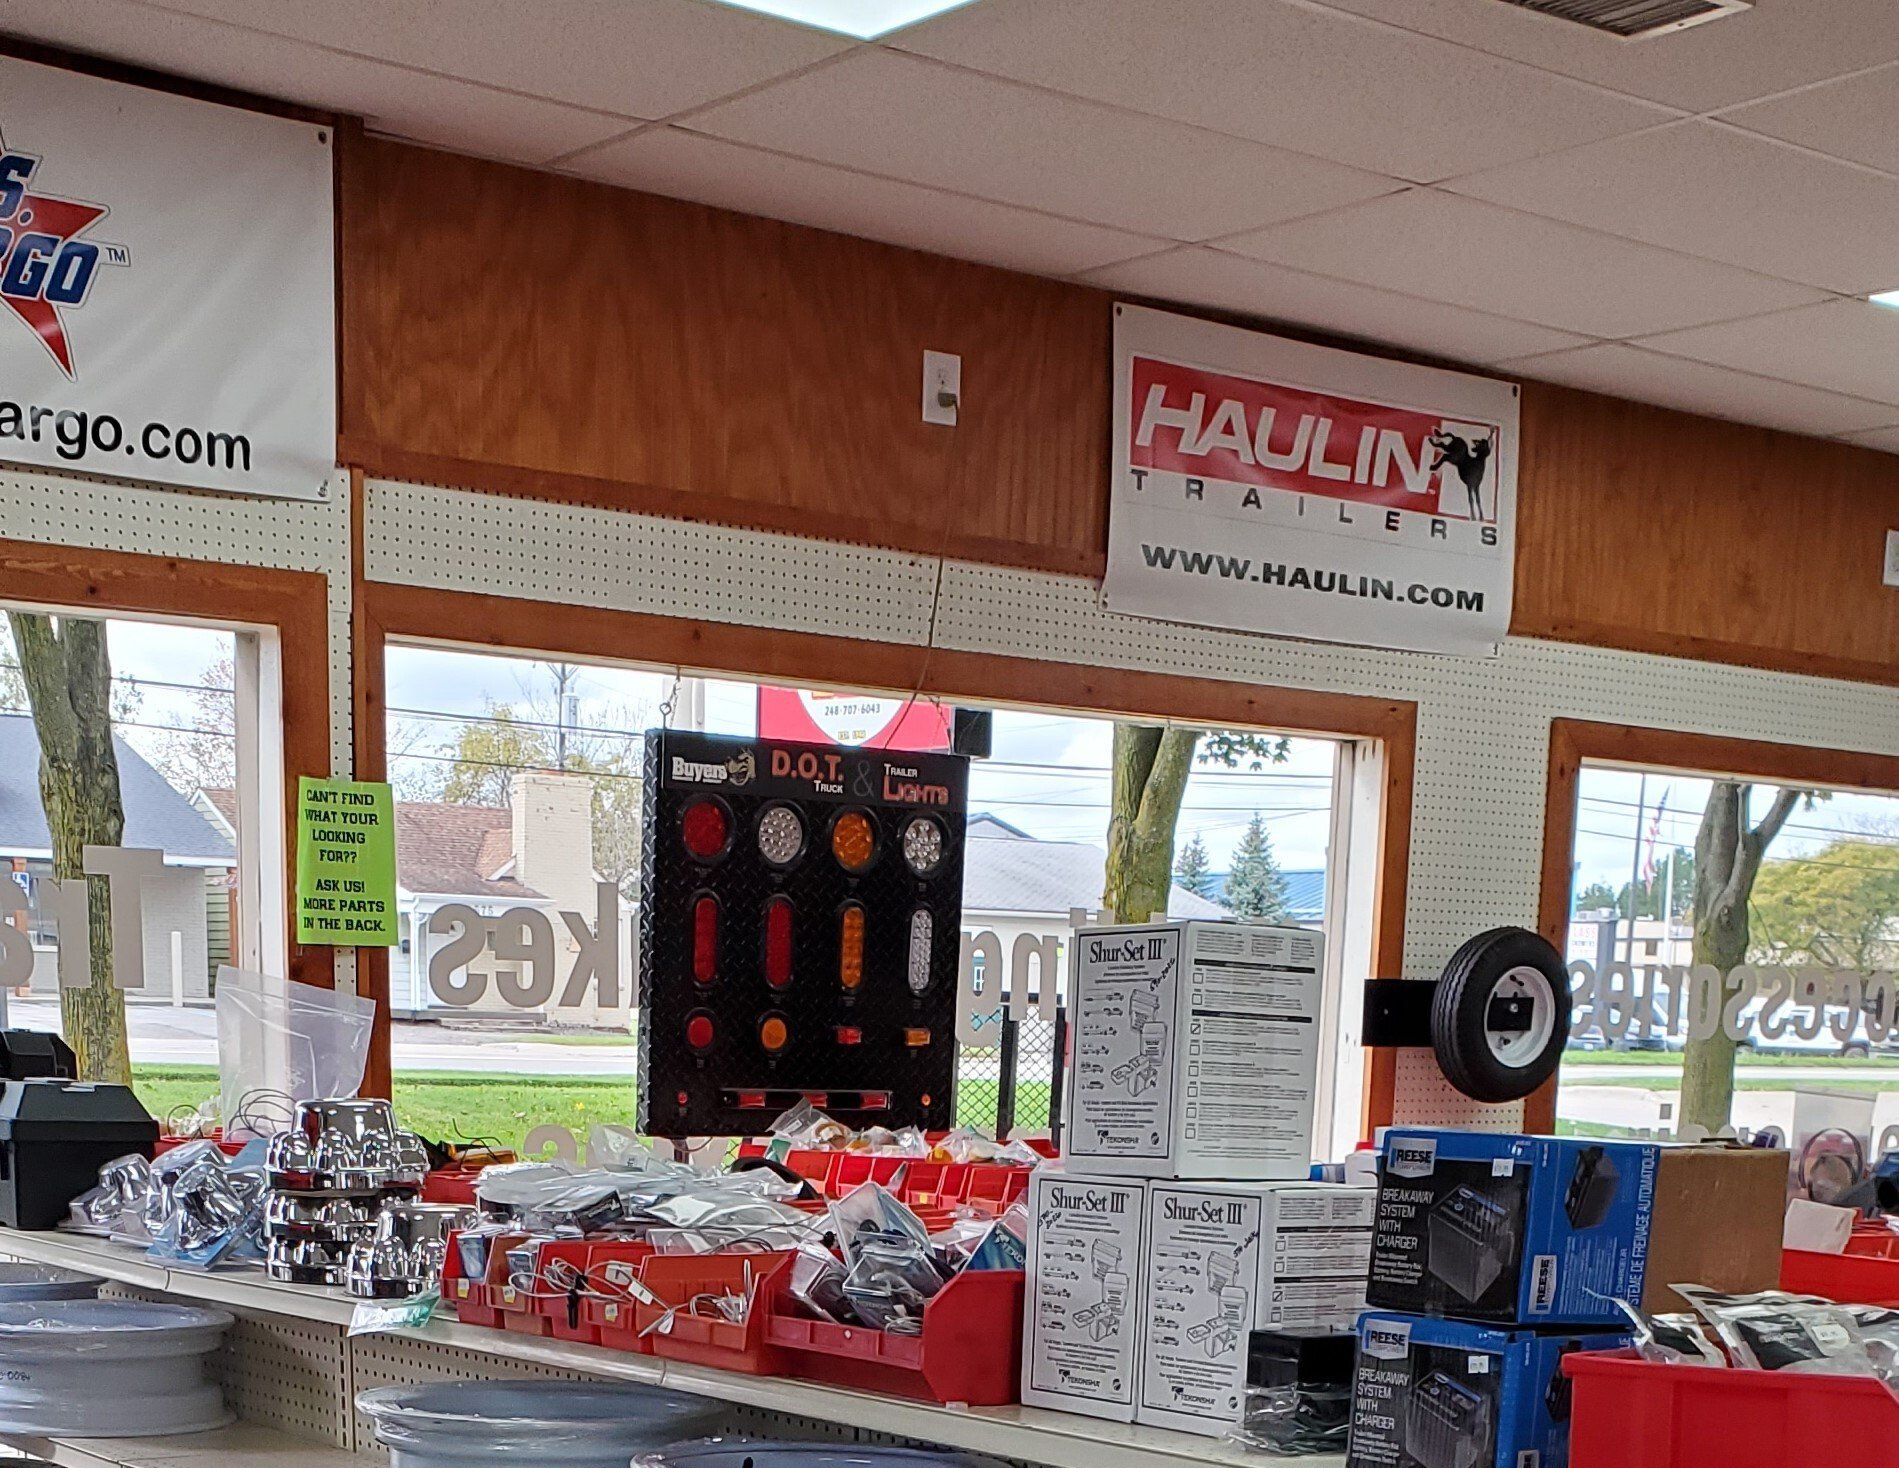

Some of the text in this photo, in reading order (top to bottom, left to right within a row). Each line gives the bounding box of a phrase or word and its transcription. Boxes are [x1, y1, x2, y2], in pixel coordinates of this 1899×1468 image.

[0, 401, 251, 471] argo.com
[1135, 384, 1445, 495] HAULIN
[1130, 469, 1498, 546] TRAILERS
[1141, 544, 1485, 613] WWW.HAULIN.COM
[671, 756, 728, 783] Buyers
[771, 749, 845, 782] D.O.T.
[306, 789, 375, 806] CAN'T FIND
[305, 808, 379, 826] WHAT YOUR
[312, 828, 366, 844] LOOKING
[319, 849, 358, 864] FOR??
[315, 878, 366, 893] ASK US!
[303, 897, 385, 913] MORE PARTS
[303, 916, 386, 932] IN THE BACK.
[1089, 939, 1145, 963] Shur-Set
[1396, 1149, 1434, 1163] REESE
[1050, 1186, 1107, 1212] Shur-Set
[1382, 1187, 1434, 1204] BREAKAWAY
[1163, 1196, 1224, 1223] Shur-Set
[1380, 1203, 1416, 1218] SYSTEM
[1379, 1219, 1401, 1232] WITH
[1377, 1234, 1418, 1250] CHARGER
[1370, 1330, 1407, 1346] REESE
[1359, 1367, 1410, 1386] BREAKAWAY
[1357, 1382, 1392, 1399] SYSTEM
[1356, 1397, 1378, 1412] WITH
[1355, 1412, 1395, 1429] CHARGER
